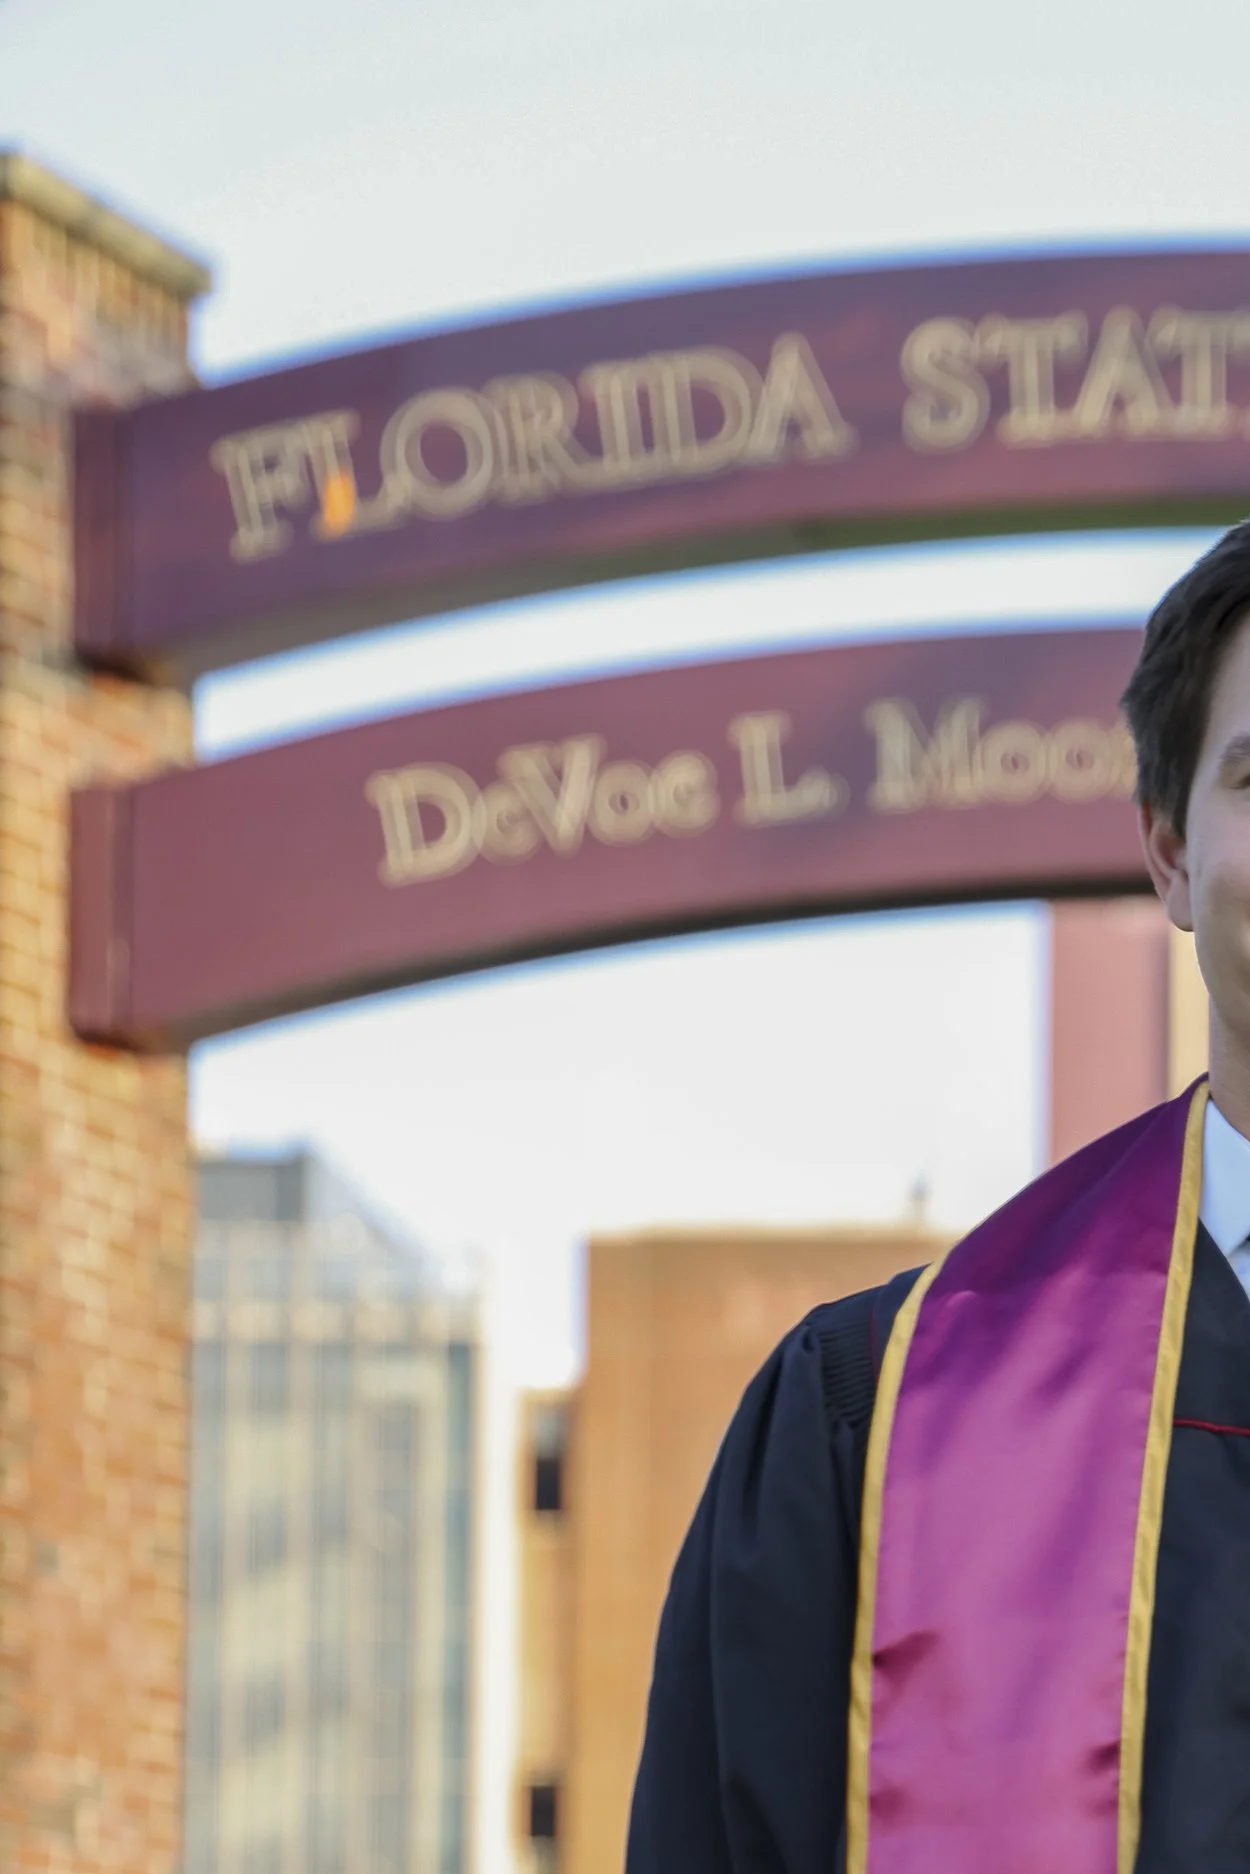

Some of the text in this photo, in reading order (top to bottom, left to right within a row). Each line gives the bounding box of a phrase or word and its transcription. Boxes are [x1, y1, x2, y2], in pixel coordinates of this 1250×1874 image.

[212, 333, 856, 561] FLORIDA
[367, 734, 717, 885] DeVoe
[866, 697, 1139, 812] Moo
